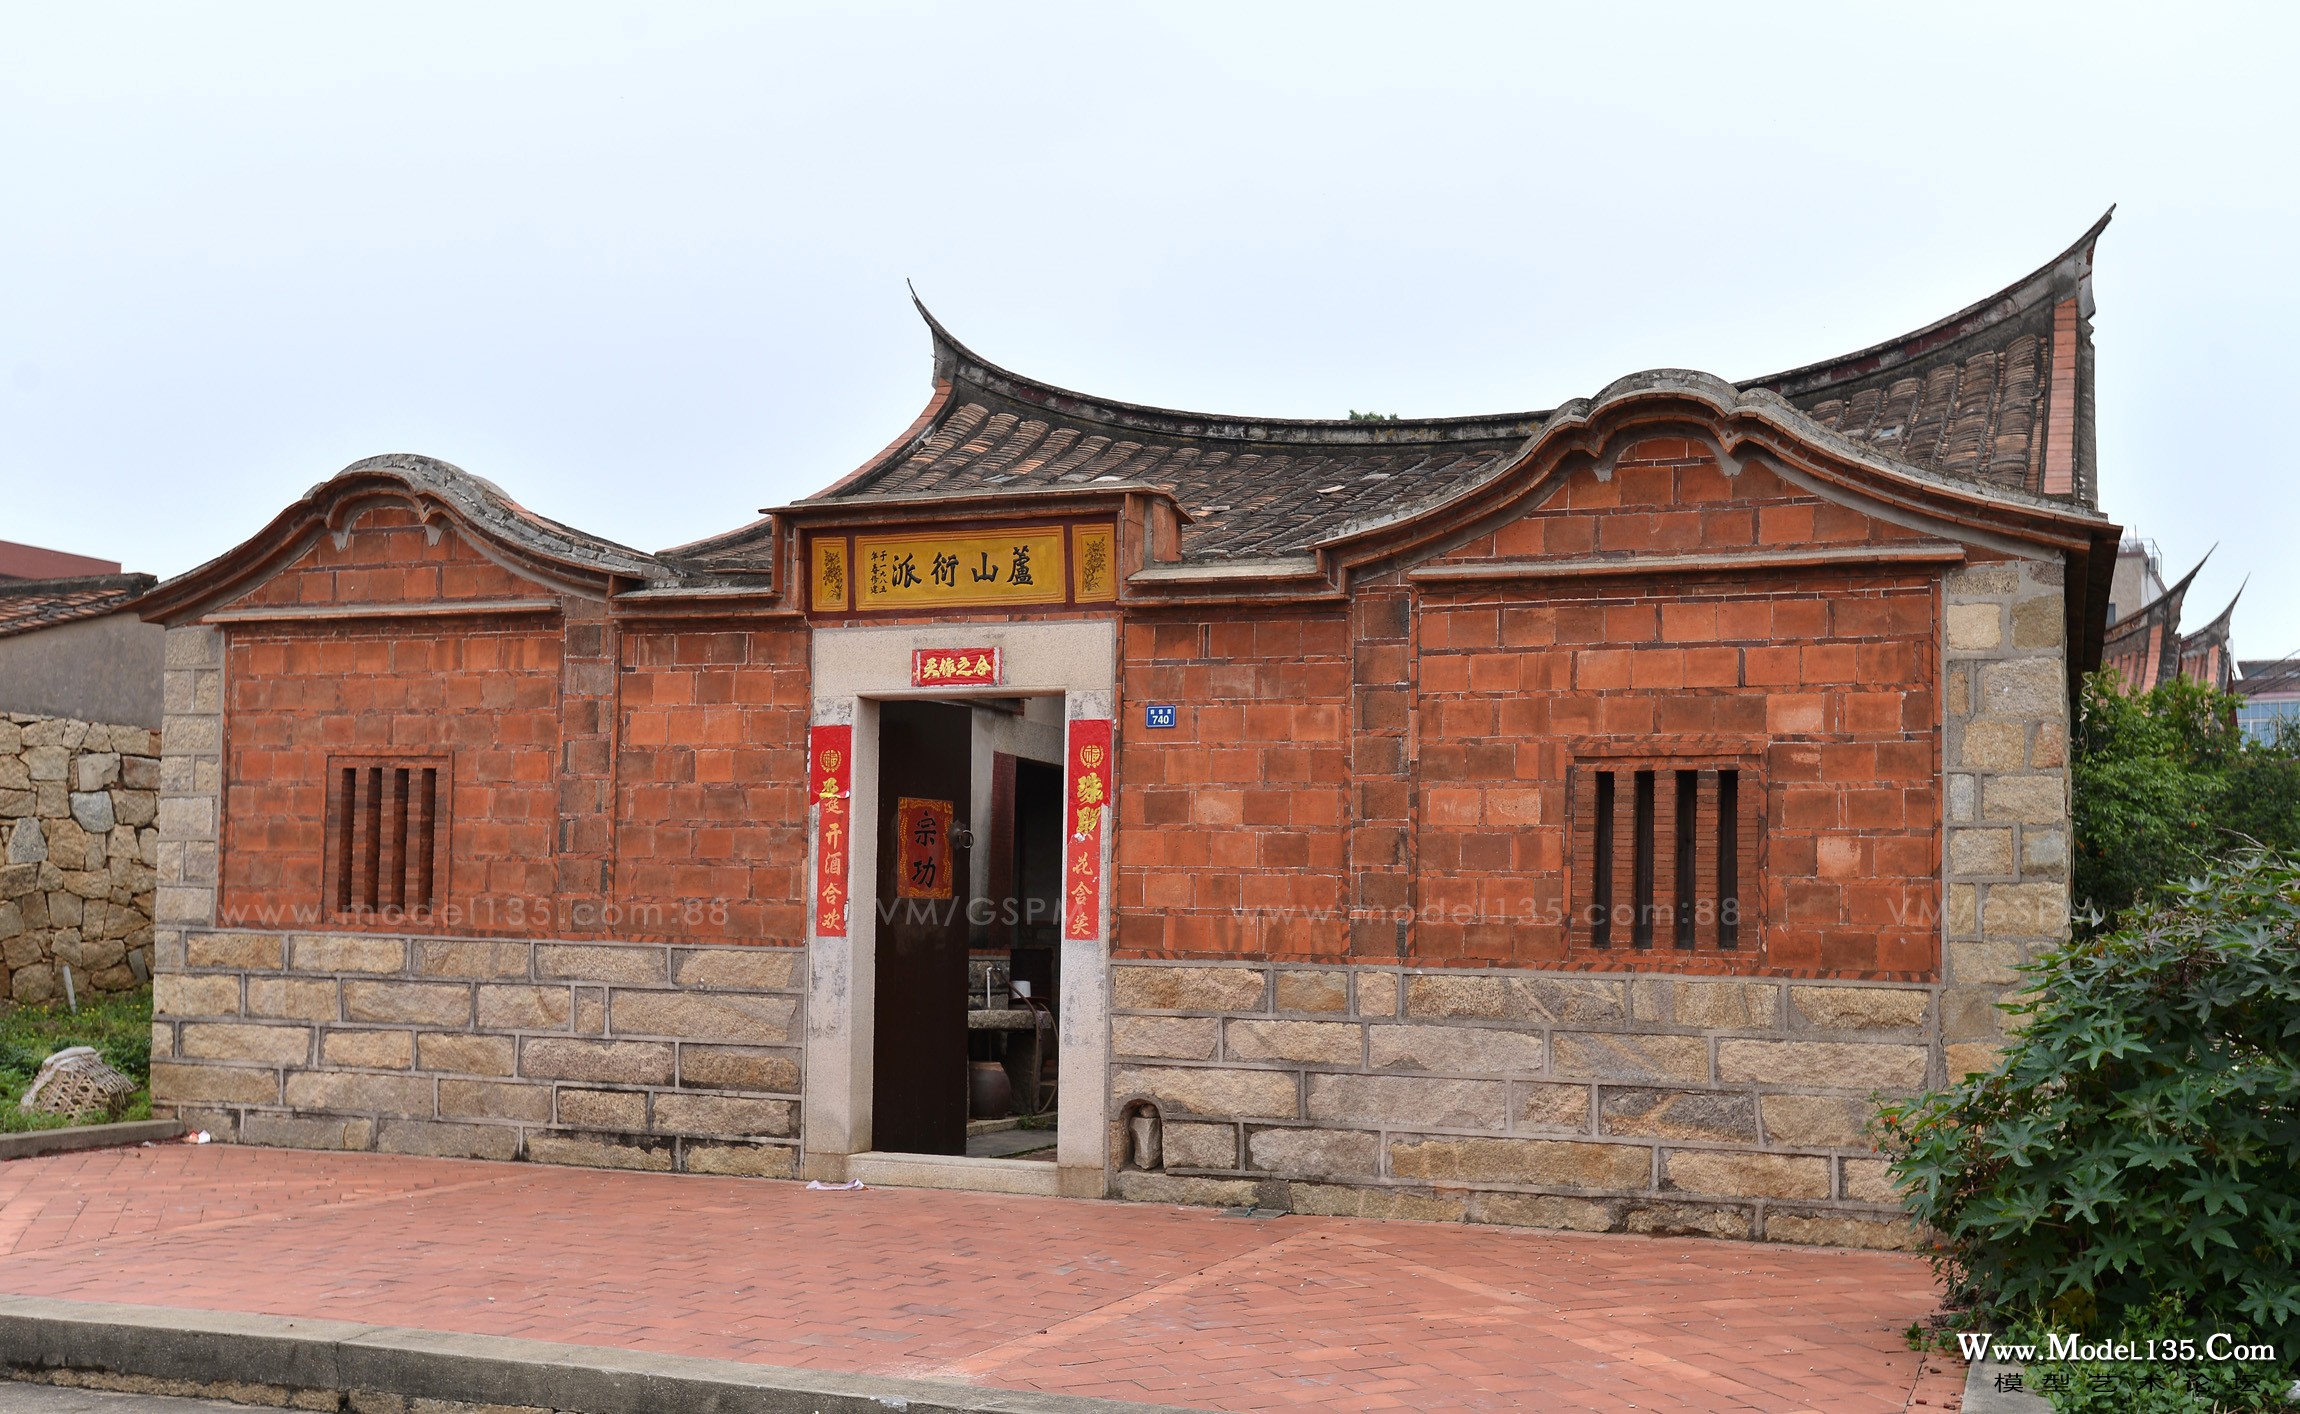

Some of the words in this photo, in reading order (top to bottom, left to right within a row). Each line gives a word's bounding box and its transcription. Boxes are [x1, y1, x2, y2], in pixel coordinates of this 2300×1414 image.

[922, 654, 991, 678] 天作之合
[1152, 715, 1169, 724] 740
[911, 810, 937, 888] 宗功
